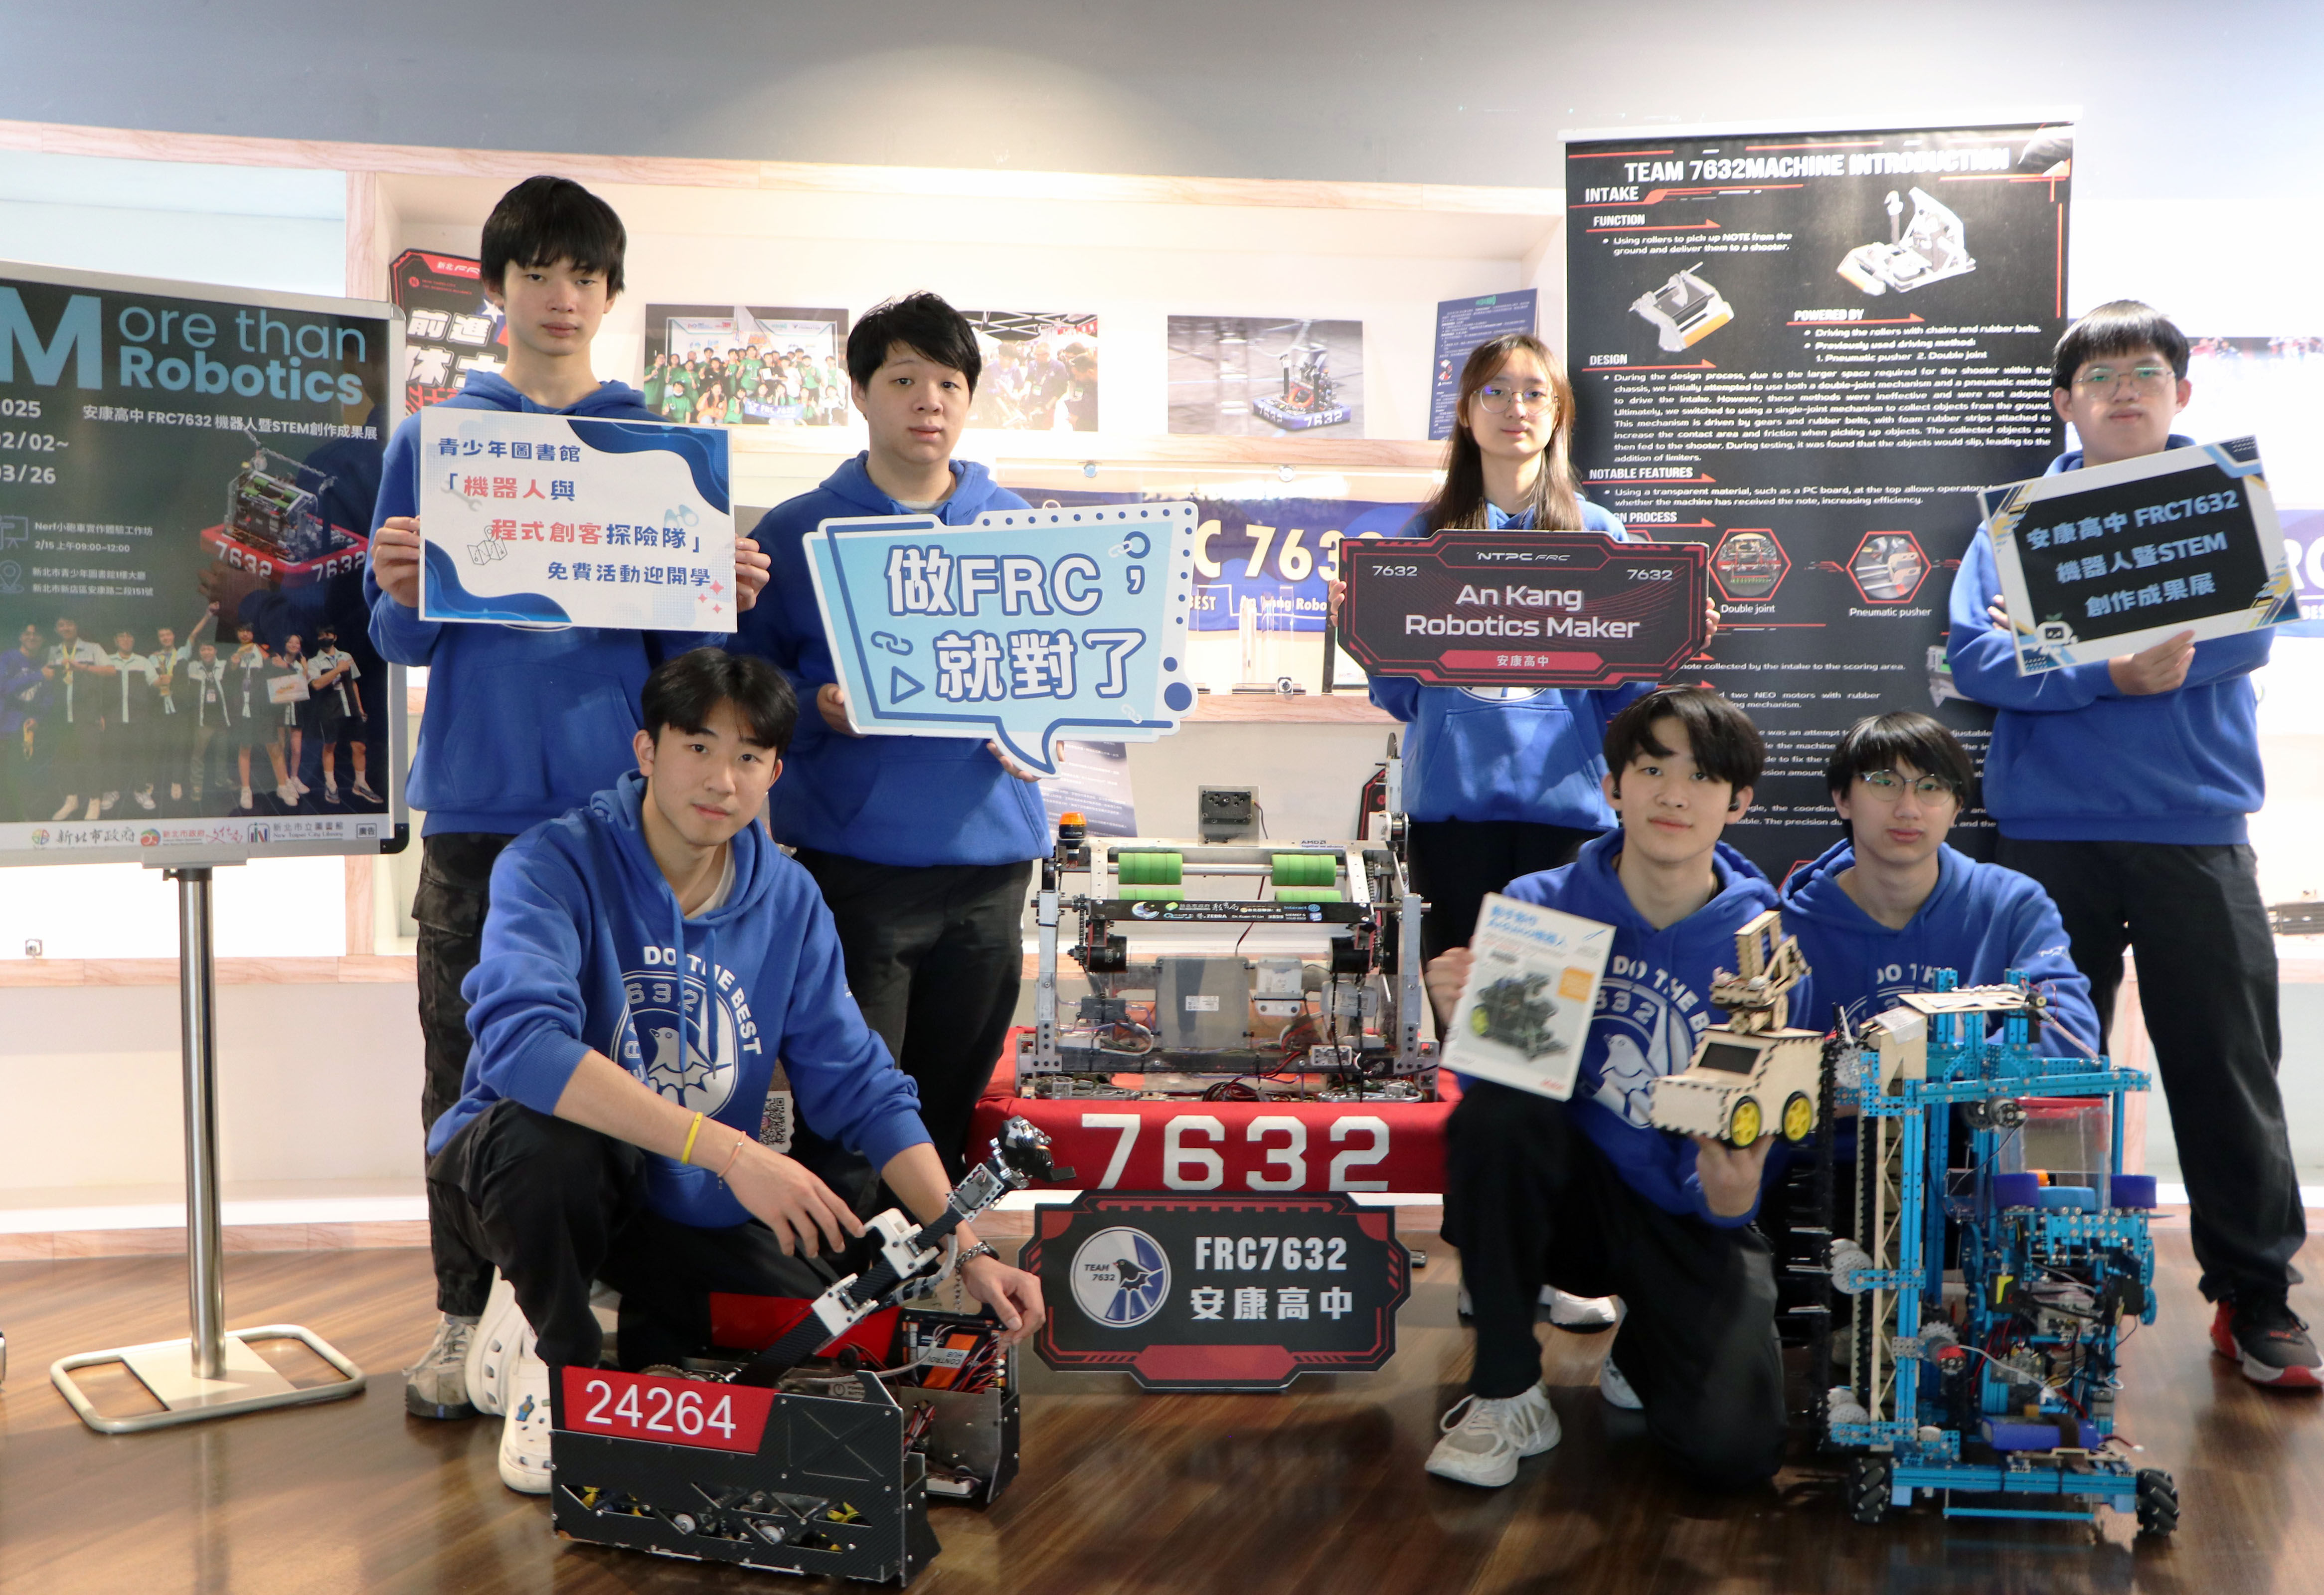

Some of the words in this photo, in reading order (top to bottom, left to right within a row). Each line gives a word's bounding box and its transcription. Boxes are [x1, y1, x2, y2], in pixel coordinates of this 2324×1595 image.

[1624, 161, 1684, 183] TEAM
[1689, 154, 1845, 181] 7632MACHINE
[1849, 148, 2009, 175] INTRODUCTION
[1585, 186, 1639, 203] INTAKE
[1593, 214, 1645, 227] FUNCTION
[1613, 236, 1640, 246] Using
[1642, 235, 1672, 244] rollers
[1686, 234, 1706, 244] pick
[1722, 233, 1751, 242] NOTE
[1751, 232, 1775, 241] from
[1776, 232, 1793, 240] the
[1613, 246, 1648, 256] ground
[1649, 246, 1668, 254] and
[1669, 244, 1702, 253] deliver
[1750, 242, 1790, 252] shooter.
[437, 261, 453, 271] 新北
[407, 309, 492, 345] 前進
[1794, 310, 1847, 321] POWERED
[1847, 309, 1864, 320] BY
[0, 286, 102, 390] M
[119, 306, 216, 348] ore
[236, 309, 365, 363] than
[1815, 328, 1850, 338] Driving
[1851, 328, 1868, 336] the
[1869, 327, 1902, 336] rollers
[1903, 326, 1924, 335] with
[1925, 325, 1958, 334] chains
[1958, 324, 1979, 333] and
[1979, 324, 2014, 333] rubber
[2014, 324, 2041, 333] belts.
[1589, 354, 1628, 366] DESIGN
[120, 346, 363, 405] Robotics
[0, 399, 41, 418] 025
[1257, 405, 1283, 423] 7632
[1303, 410, 1343, 428] 7632
[83, 404, 144, 423] 安康高中
[148, 411, 211, 429] FRC7632
[214, 415, 378, 441] 機器人暨STEM創作成果展
[0, 431, 69, 452] 2/02~
[438, 438, 581, 463] 青少年圖書館
[0, 464, 56, 484] 3/26
[1589, 468, 1637, 479] NOTABLE
[1639, 467, 1693, 478] FEATURES
[448, 473, 576, 502] 「機器人與
[1615, 488, 1641, 497] Using
[1653, 488, 1709, 496] transparent
[1711, 487, 1752, 496] material,
[1820, 486, 1851, 495] board,
[1885, 486, 1901, 494] top
[1630, 512, 1677, 522] PROCESS
[2026, 512, 2128, 550] 安康高中
[2134, 489, 2240, 528] FRC7632
[35, 539, 54, 550] 2/15
[491, 518, 700, 553] 程式創客探險隊」
[214, 540, 272, 578] 7632
[1244, 524, 1385, 582] 763
[1476, 551, 1532, 561] NTPC
[2055, 531, 2228, 584] 機器人暨STEM
[311, 551, 366, 582] 7632
[548, 561, 710, 587] 免費活動迎開學
[1372, 565, 1418, 577] 7632
[1627, 569, 1673, 581] 7632
[1296, 598, 1327, 611] Robo
[1455, 585, 1498, 606] An
[1506, 585, 1583, 612] Kang
[2085, 572, 2216, 618] 創作成果展
[1721, 604, 1754, 613] Double
[1754, 604, 1775, 615] joint
[1849, 608, 1897, 617] Pneumatic
[1899, 607, 1932, 618] pusher
[1405, 615, 1540, 637] Robotics
[1546, 616, 1640, 639] Maker
[932, 628, 1147, 702] 就對了
[1496, 654, 1549, 667] 安康高中
[56, 826, 135, 844] 新北市政府
[359, 827, 375, 835] 廣告
[1612, 955, 1648, 979] DO
[626, 982, 700, 1012] 632
[644, 946, 676, 965] DO
[731, 987, 762, 1055] BEST
[1081, 1114, 1390, 1192] 7632
[1195, 1237, 1347, 1271] FRC7632
[1190, 1285, 1352, 1320] 安康高中
[584, 1379, 736, 1440] 24264
